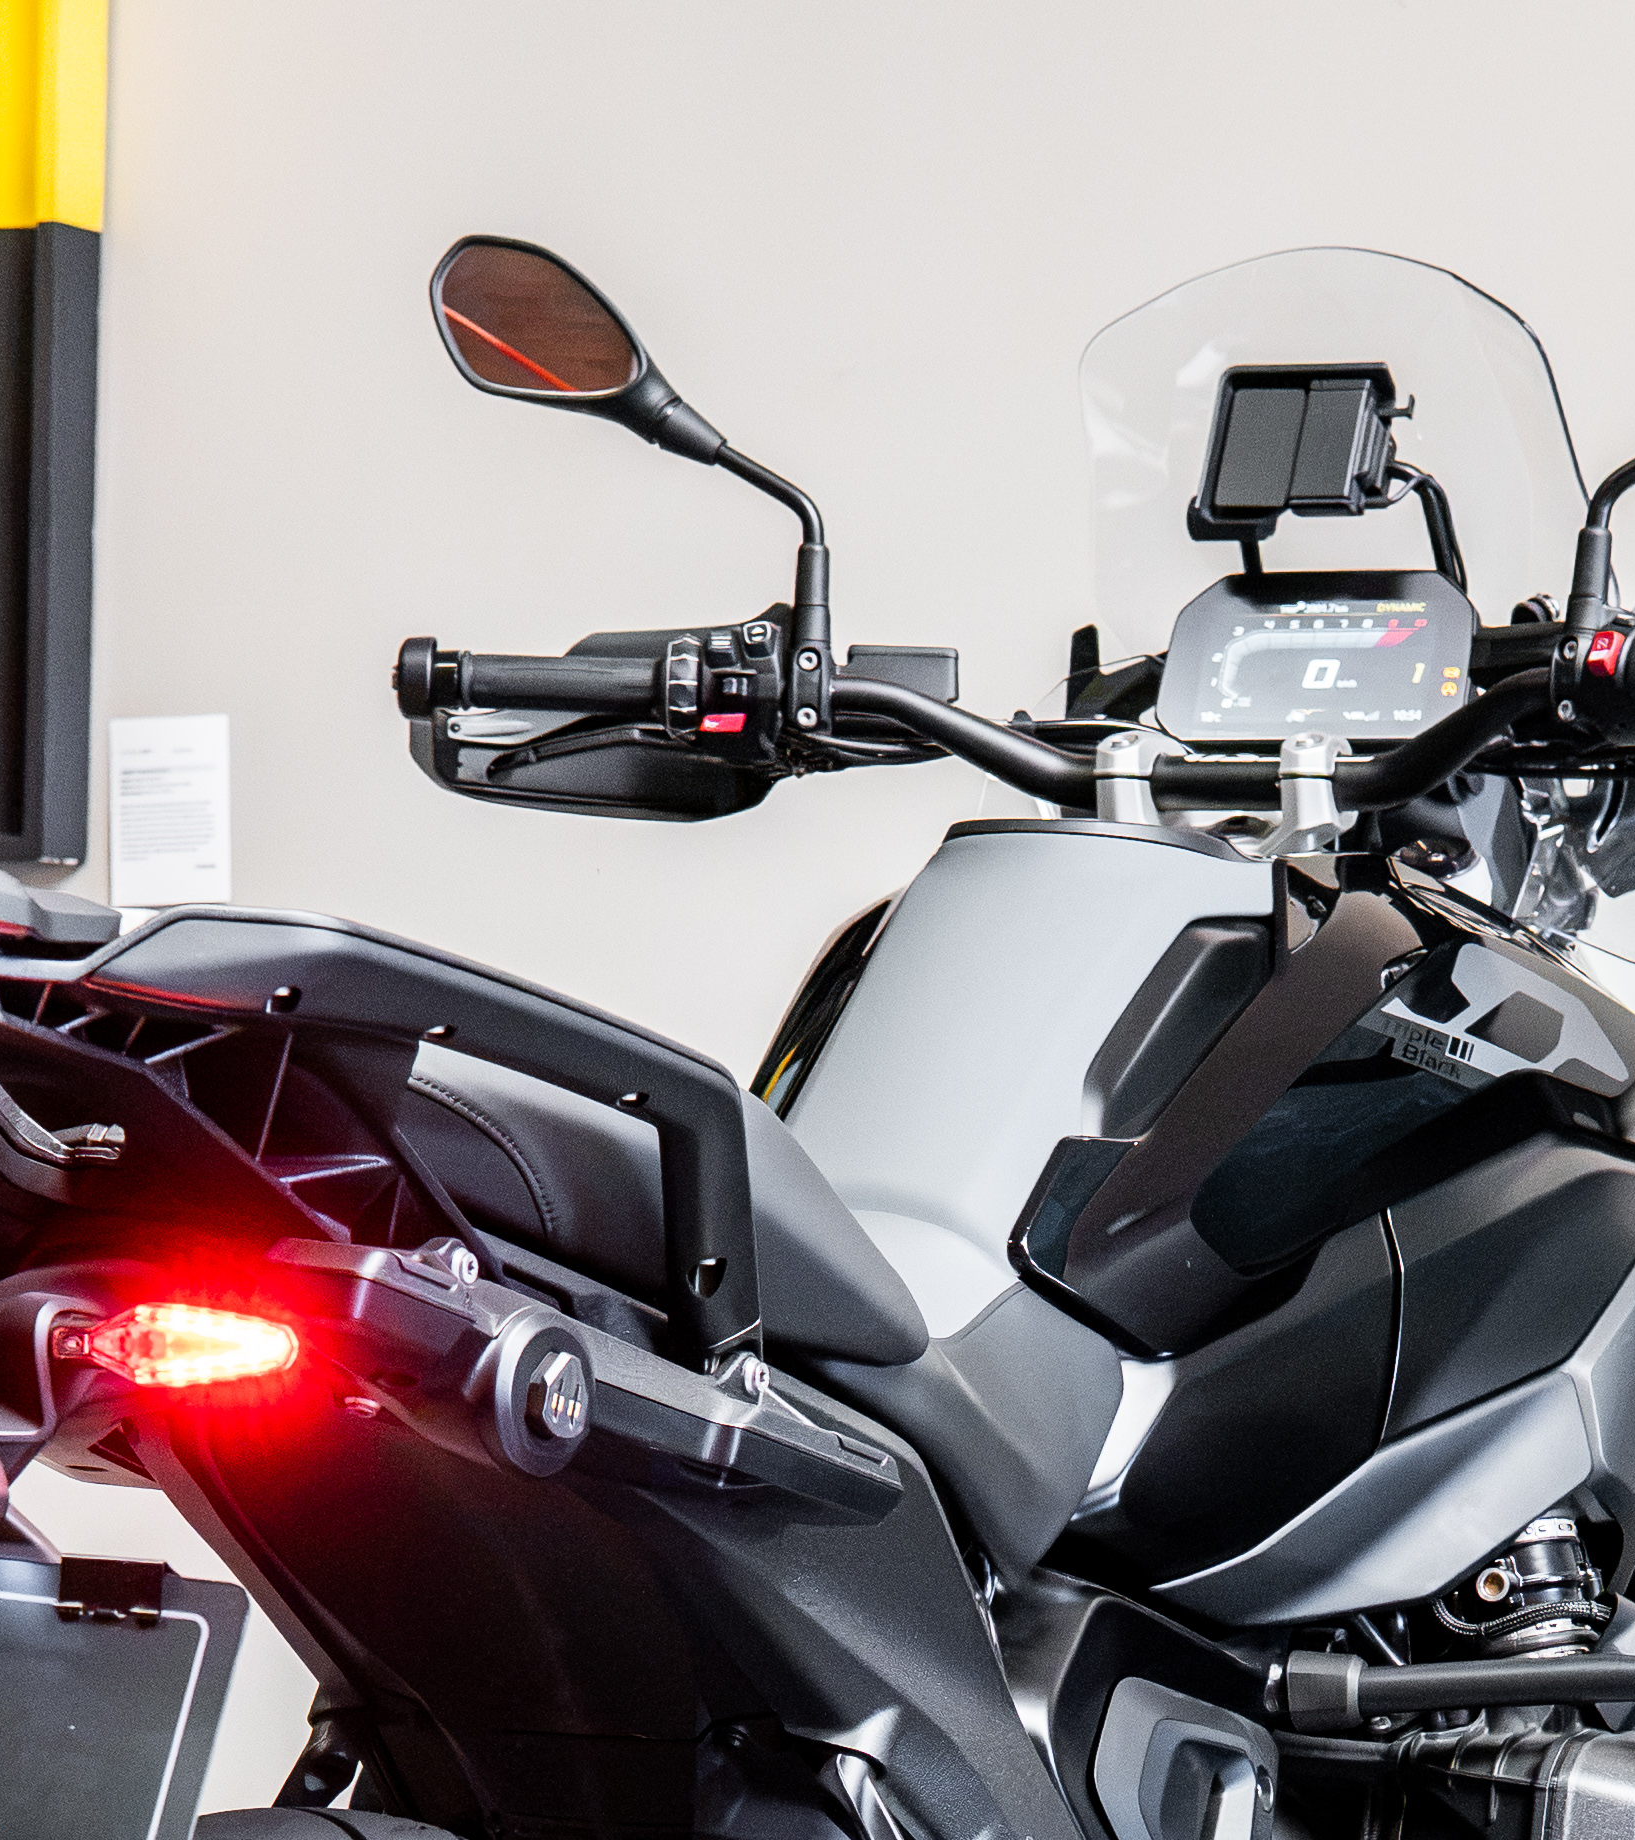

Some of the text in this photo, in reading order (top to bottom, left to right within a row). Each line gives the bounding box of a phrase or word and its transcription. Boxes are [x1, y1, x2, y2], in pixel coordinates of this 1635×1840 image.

[1302, 659, 1341, 689] 0
[1412, 662, 1426, 684] 1
[1383, 1018, 1446, 1049] Triple
[1402, 1043, 1462, 1080] Black
